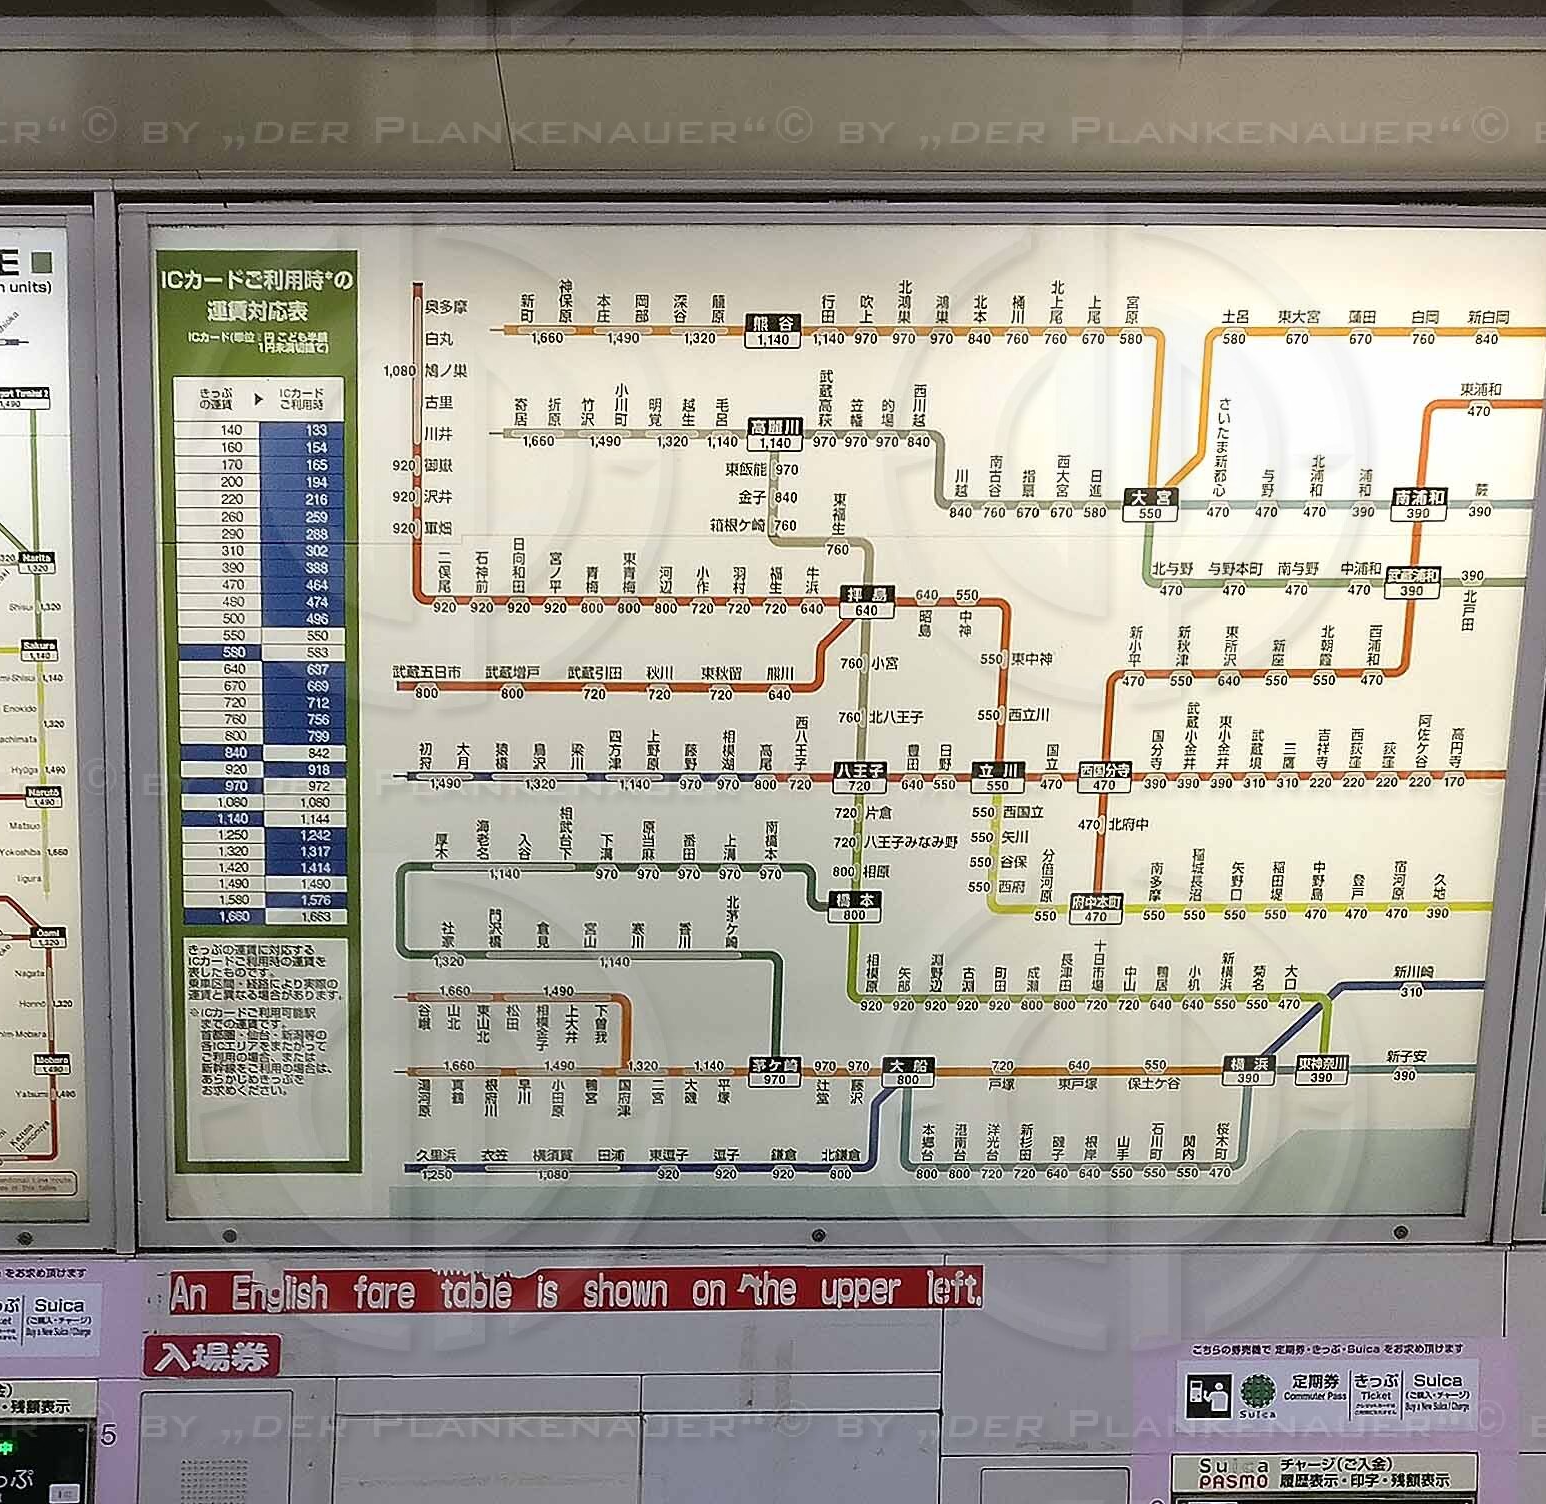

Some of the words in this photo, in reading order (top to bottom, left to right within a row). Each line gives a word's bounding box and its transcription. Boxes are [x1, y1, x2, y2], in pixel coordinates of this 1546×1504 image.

[9, 281, 52, 294] units)
[207, 300, 309, 322] 運賃対応表
[1278, 309, 1321, 325] 東大宮
[1411, 309, 1440, 325] 白岡
[1467, 309, 1510, 325] 新白岡
[425, 331, 454, 348] 白丸
[758, 333, 792, 347] 1,140
[383, 364, 416, 378] 1,080
[200, 388, 233, 398] きっぷ
[280, 388, 324, 398] ICカード
[1460, 382, 1502, 398] 東浦和
[425, 394, 454, 410] 古里
[221, 425, 243, 435] 140
[425, 426, 453, 442] 川井
[221, 442, 243, 452] 160
[1217, 398, 1232, 498] さいたま新都心
[725, 462, 767, 478] 東飯能
[222, 494, 244, 505] 220
[424, 489, 453, 505] 沢井
[1131, 488, 1171, 505] 大宮
[1395, 488, 1445, 506] 南浦和
[22, 553, 52, 564] Narita
[512, 538, 526, 594] 日向和田
[1153, 561, 1194, 576] 北与野
[1208, 561, 1264, 577] 与野本町
[1278, 561, 1320, 576] 南与野
[1341, 561, 1382, 576] 中浦和
[223, 579, 245, 590] 470
[23, 640, 56, 652] Sakura
[392, 664, 462, 680] 武蔵五日市
[485, 664, 541, 680] 武蔵増戸
[567, 665, 623, 681] 武蔵引田
[645, 665, 674, 681] 秋川
[224, 697, 246, 707] 720
[308, 698, 329, 708] 712
[869, 709, 924, 725] 北八王子
[1007, 708, 1050, 723] 西立川
[225, 764, 247, 774] 920
[308, 765, 329, 775] 918
[835, 762, 885, 779] 八王子
[1079, 763, 1131, 779] 西国分寺
[866, 805, 893, 821] 片倉
[1002, 805, 1044, 820] 西国立
[1108, 816, 1149, 832] 北府中
[864, 834, 958, 850] 八王子みなみ野
[1071, 894, 1122, 911] 府中本町
[1393, 964, 1434, 980] 新川崎
[1297, 1056, 1349, 1072] 東神奈川
[1386, 1049, 1428, 1064] 新子安
[171, 1276, 207, 1312] An
[232, 1275, 328, 1314] English
[355, 1275, 415, 1310] fare
[441, 1274, 512, 1310] table
[537, 1274, 558, 1308] is
[583, 1272, 667, 1308] shown
[693, 1278, 726, 1306] on
[751, 1271, 796, 1307] the
[821, 1277, 901, 1308] upper
[927, 1270, 982, 1306] left.
[35, 1298, 85, 1313] Suica
[153, 1341, 270, 1373] 入場券
[1292, 1374, 1340, 1389] 定期券
[1354, 1373, 1400, 1388] きっぷ
[1414, 1373, 1463, 1388] Suica
[101, 1424, 117, 1447] 5
[1199, 1474, 1269, 1489] PASMO
[1280, 1473, 1451, 1489] 履歴表示・印字・残額表示
